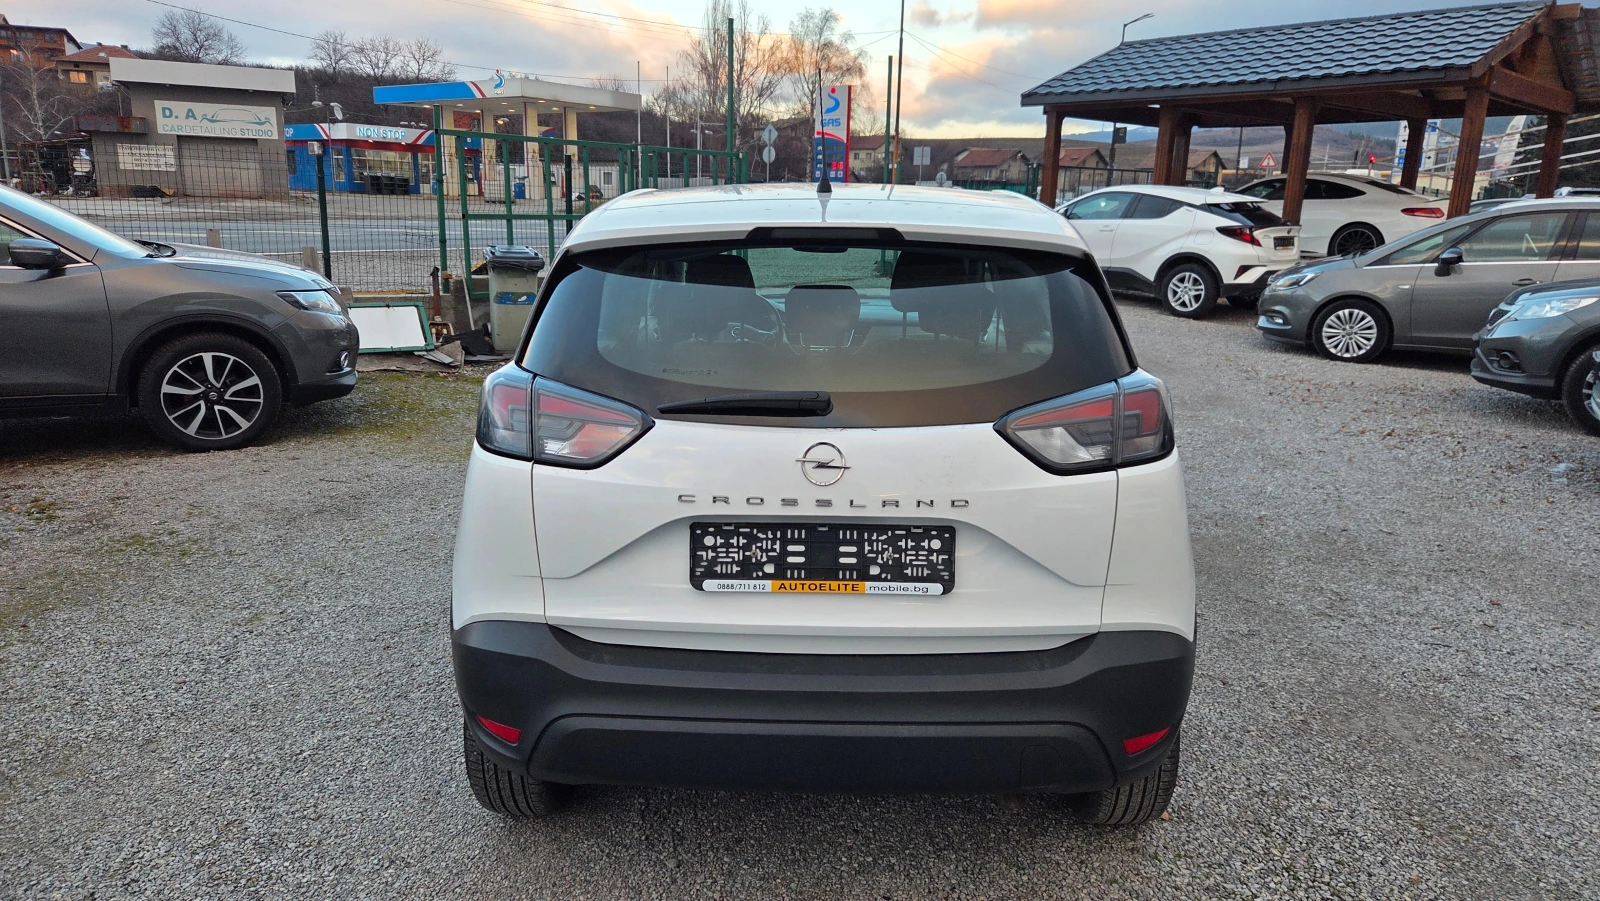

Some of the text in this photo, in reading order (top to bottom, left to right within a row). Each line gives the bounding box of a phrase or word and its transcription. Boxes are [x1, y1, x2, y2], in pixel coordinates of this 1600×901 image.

[161, 106, 198, 120] D. A
[820, 117, 841, 127] GAS
[162, 123, 274, 138] CARDETAILING STUDIO
[357, 127, 406, 140] NON STOP
[677, 493, 970, 508] CROSSLAND
[717, 583, 751, 591] 0888/711
[752, 583, 766, 591] 812
[777, 582, 860, 592] AUTOELITE
